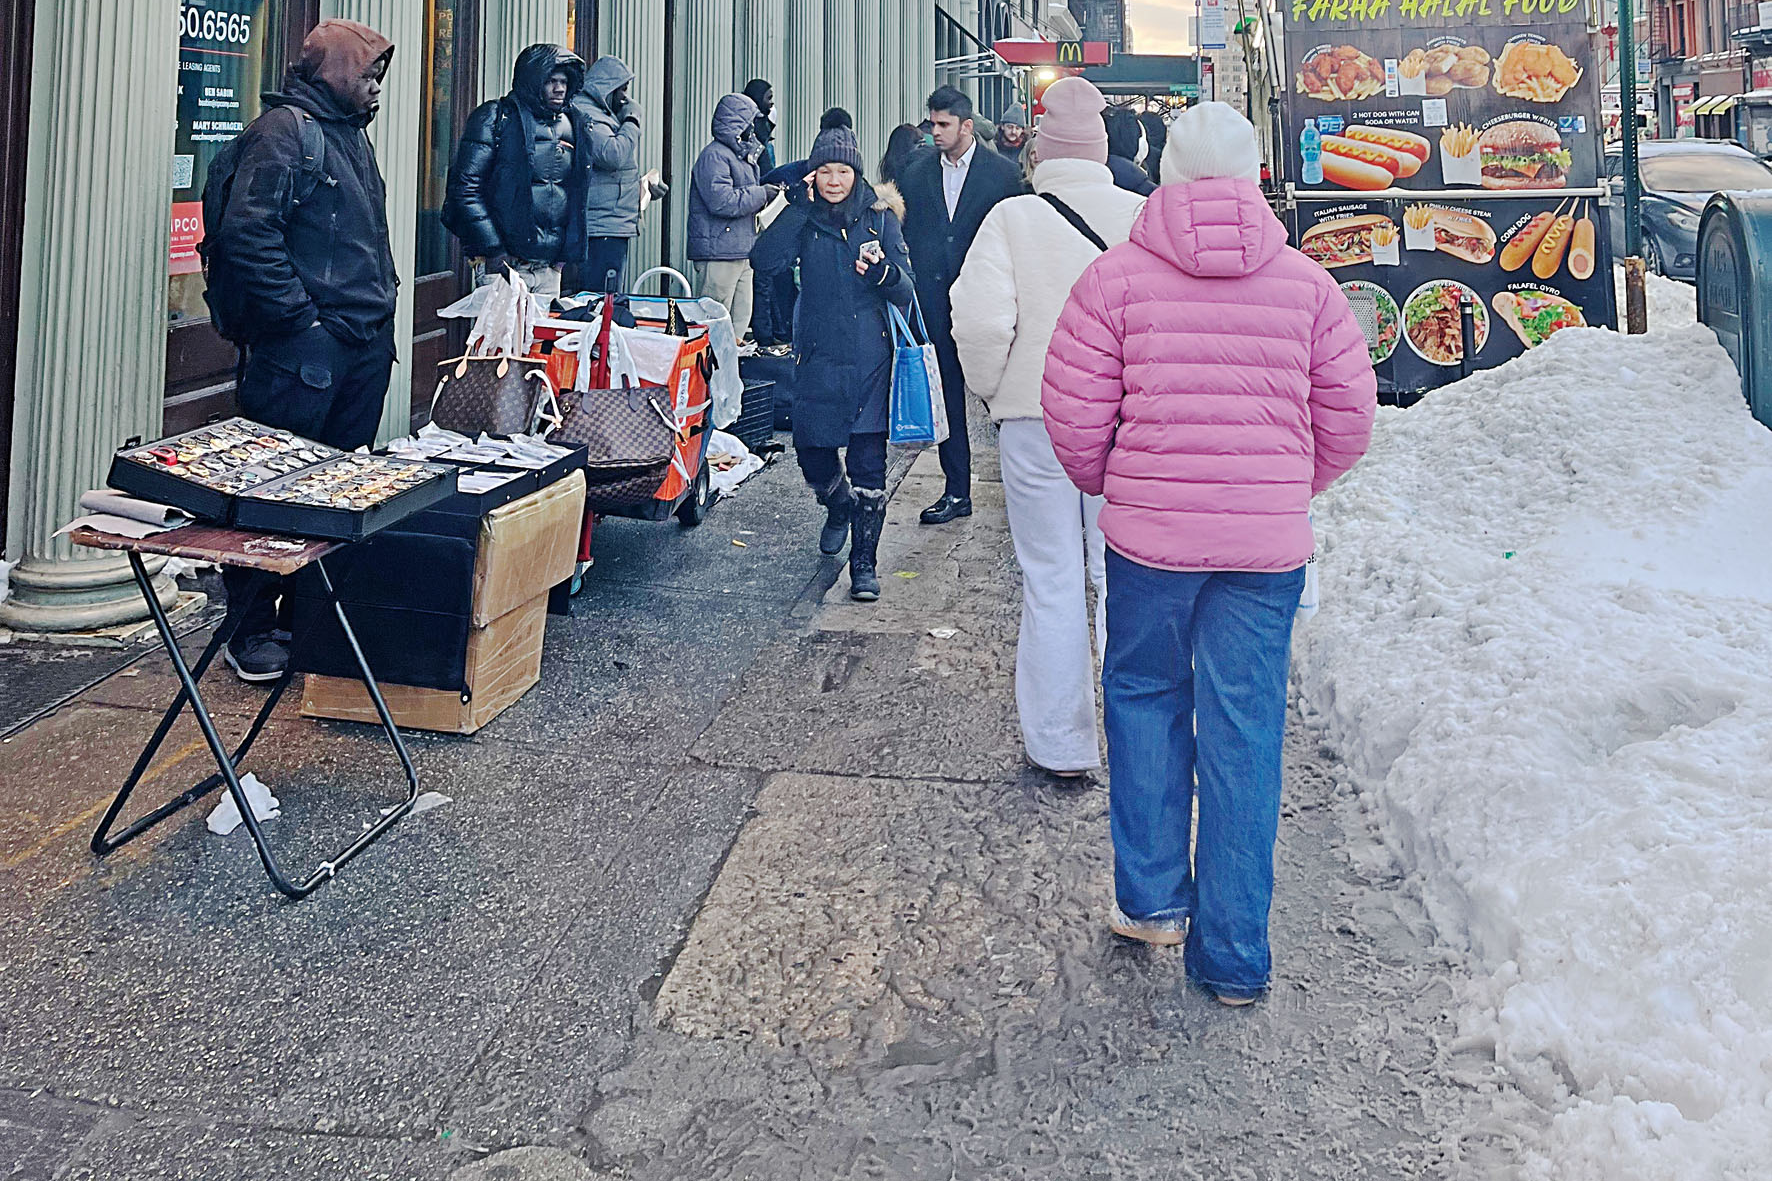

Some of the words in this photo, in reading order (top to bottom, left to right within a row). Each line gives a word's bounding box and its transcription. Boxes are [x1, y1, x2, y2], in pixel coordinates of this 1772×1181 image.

[182, 61, 203, 72] LEASING
[203, 63, 221, 74] AGENTS
[192, 120, 211, 131] MARY
[1482, 112, 1531, 130] CHEESEBURGER
[1531, 113, 1558, 130] W/FRIES
[1313, 206, 1337, 218] ITALIAN
[1338, 203, 1368, 212] SAUSAGE
[1429, 203, 1450, 211] PHILLY
[1450, 205, 1472, 215] CHEESE
[1472, 209, 1492, 218] STEAK
[1318, 215, 1336, 224] WITH
[1335, 212, 1355, 220] FRIES
[1500, 224, 1518, 242] CORN
[1515, 212, 1532, 227] DOG
[1507, 282, 1538, 291] FALAFEL
[1539, 284, 1561, 296] GYRO
